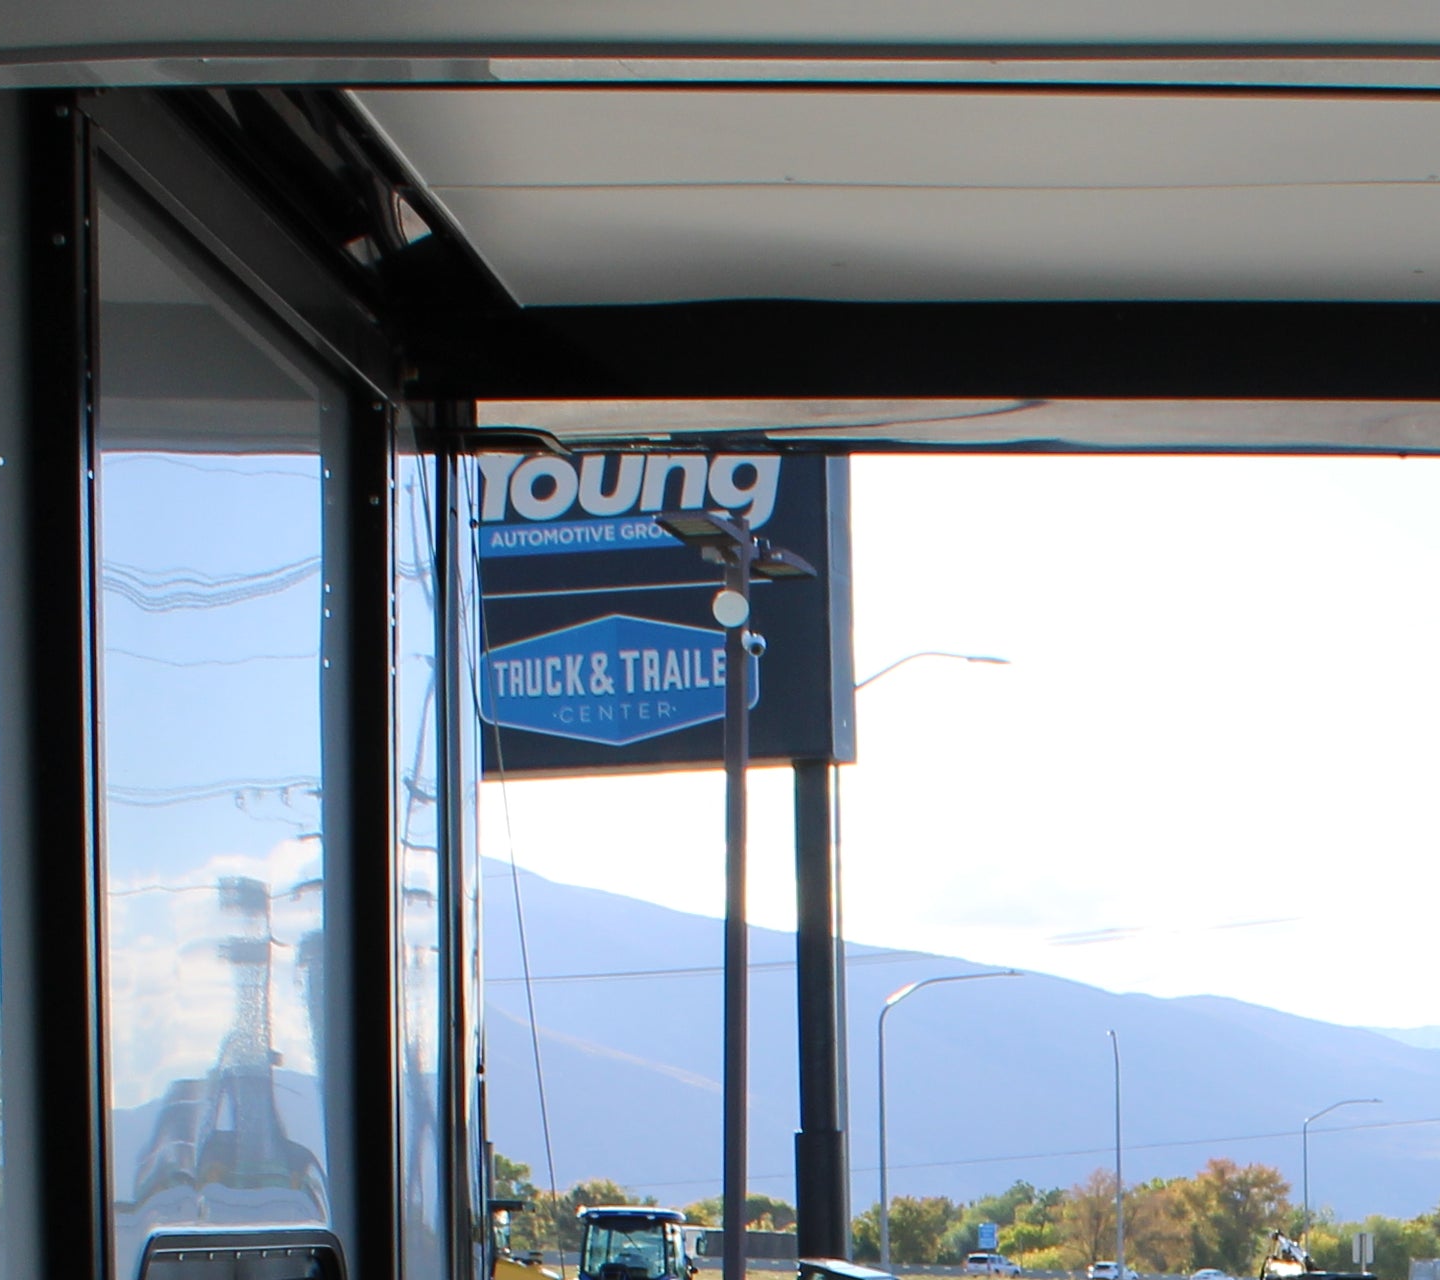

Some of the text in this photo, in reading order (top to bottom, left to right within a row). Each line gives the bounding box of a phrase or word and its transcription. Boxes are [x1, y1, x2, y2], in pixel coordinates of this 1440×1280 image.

[477, 453, 782, 531] Young
[491, 523, 616, 548] AUTOMOTIVE
[493, 649, 727, 698] TRUCK & TRAILE
[560, 702, 674, 723] CENTER
